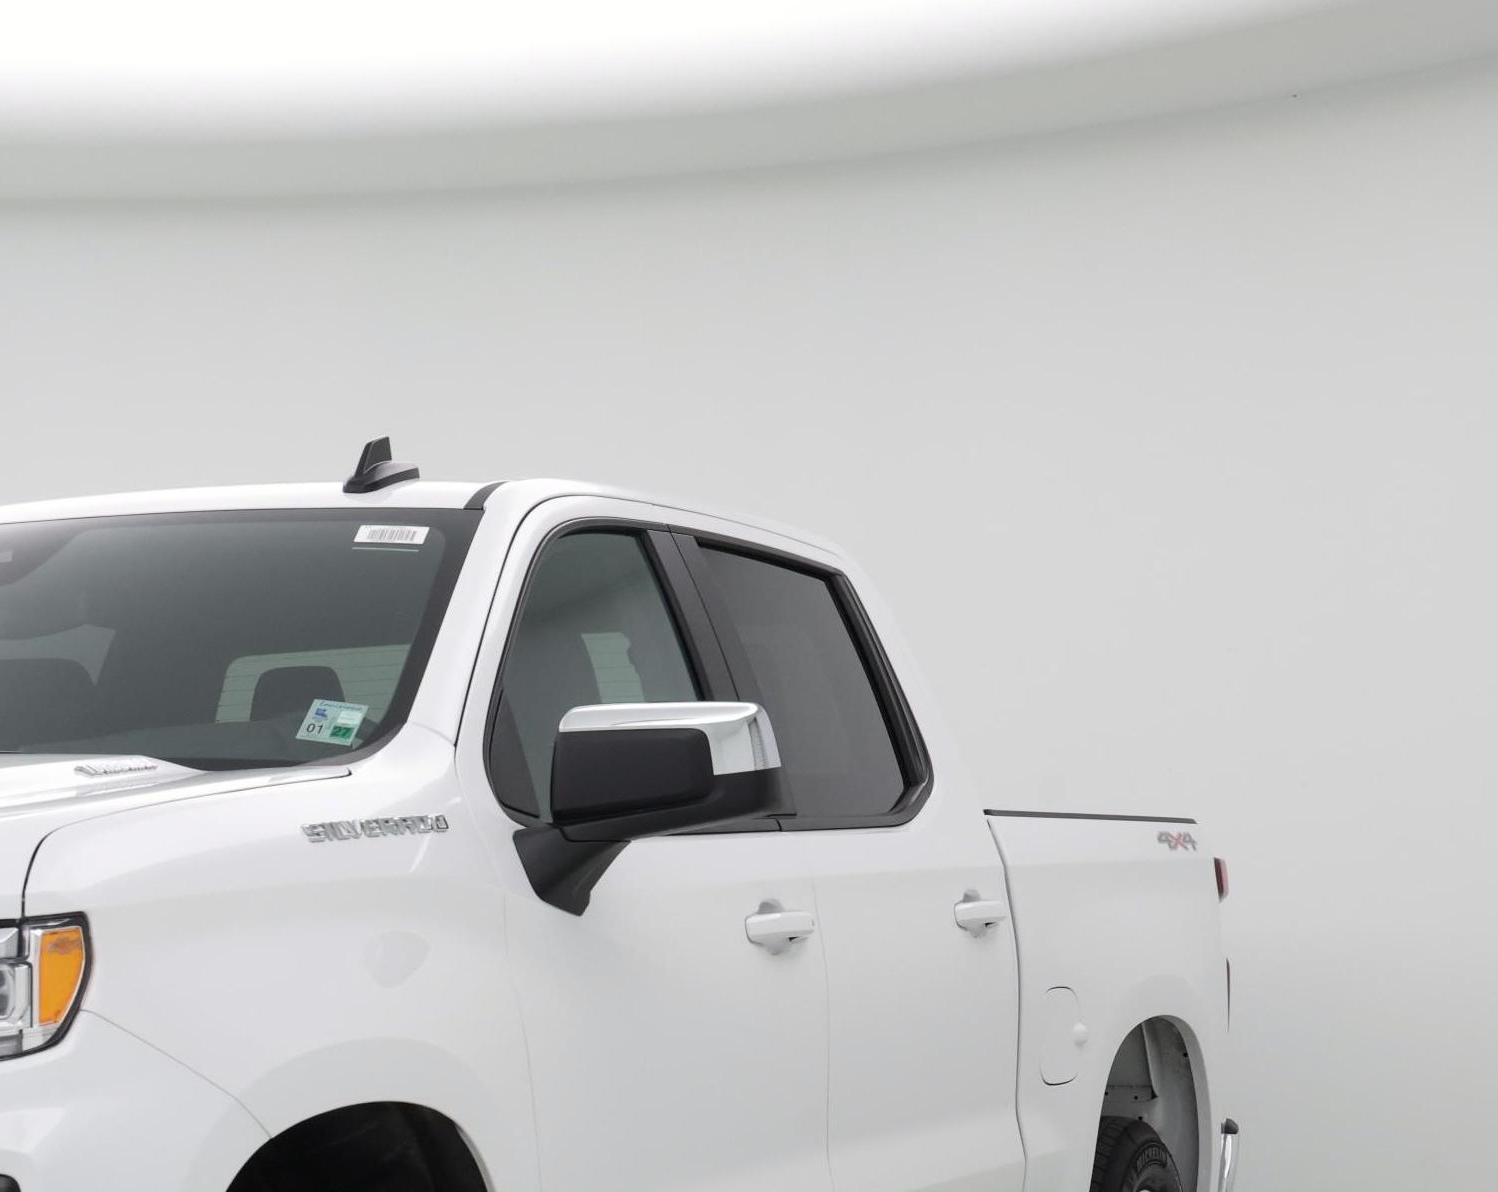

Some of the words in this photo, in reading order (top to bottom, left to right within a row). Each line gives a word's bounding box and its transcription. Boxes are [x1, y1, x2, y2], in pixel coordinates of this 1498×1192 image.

[306, 723, 324, 734] 01
[331, 726, 351, 738] 27
[301, 814, 449, 843] SILVERADO
